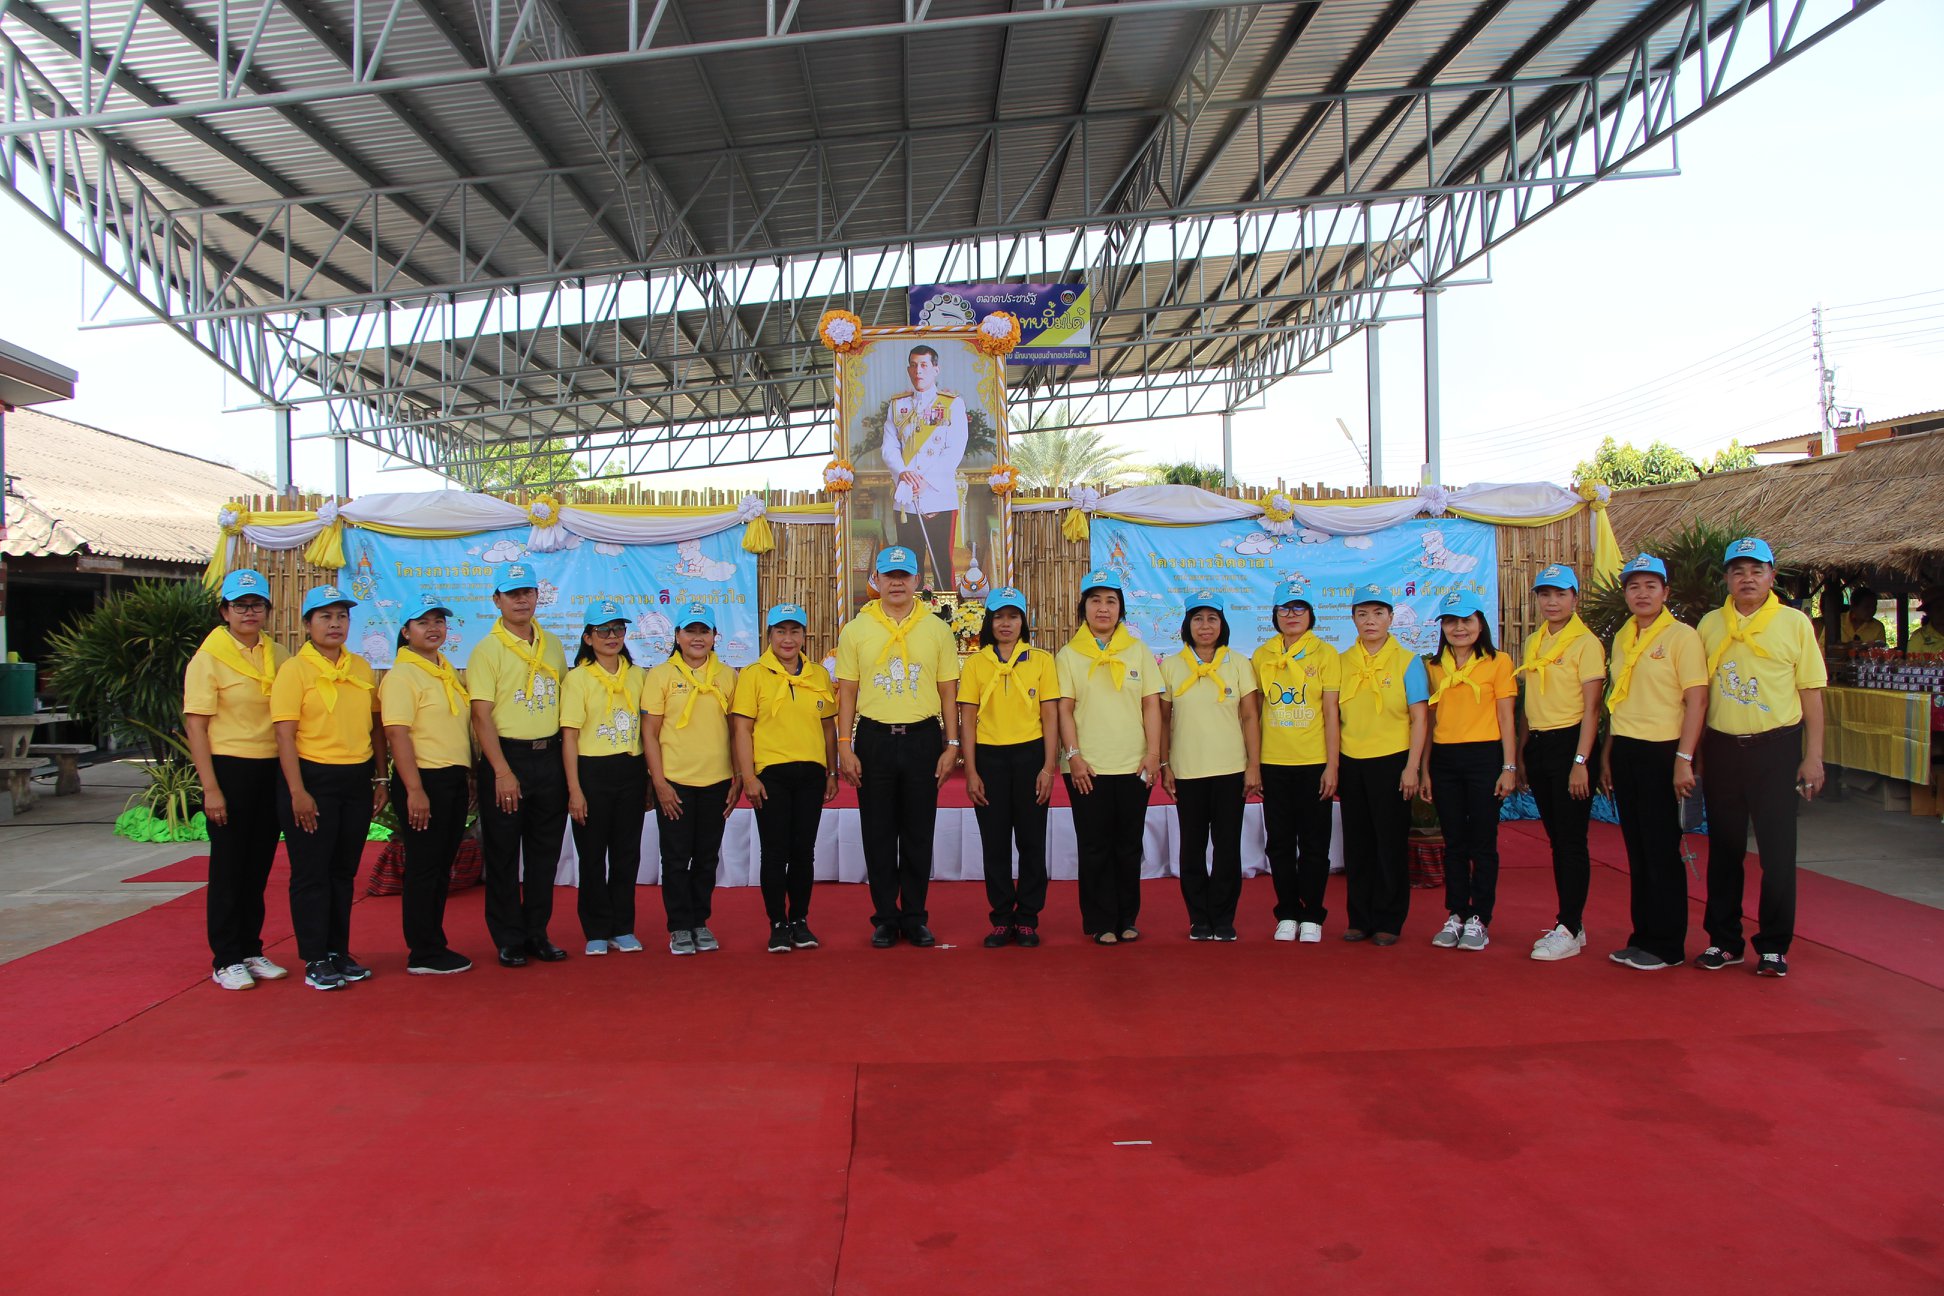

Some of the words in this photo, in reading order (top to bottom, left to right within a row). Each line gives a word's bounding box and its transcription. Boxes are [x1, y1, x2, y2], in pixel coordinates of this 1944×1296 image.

[976, 292, 1038, 306] ตลาดประชารัฐ
[1011, 301, 1086, 329] ทยยิ้มได้
[395, 561, 500, 577] โครงการจิตอ
[1148, 553, 1274, 569] โครงการจิตอาสา
[659, 589, 670, 605] ดี
[1405, 581, 1416, 597] ดี
